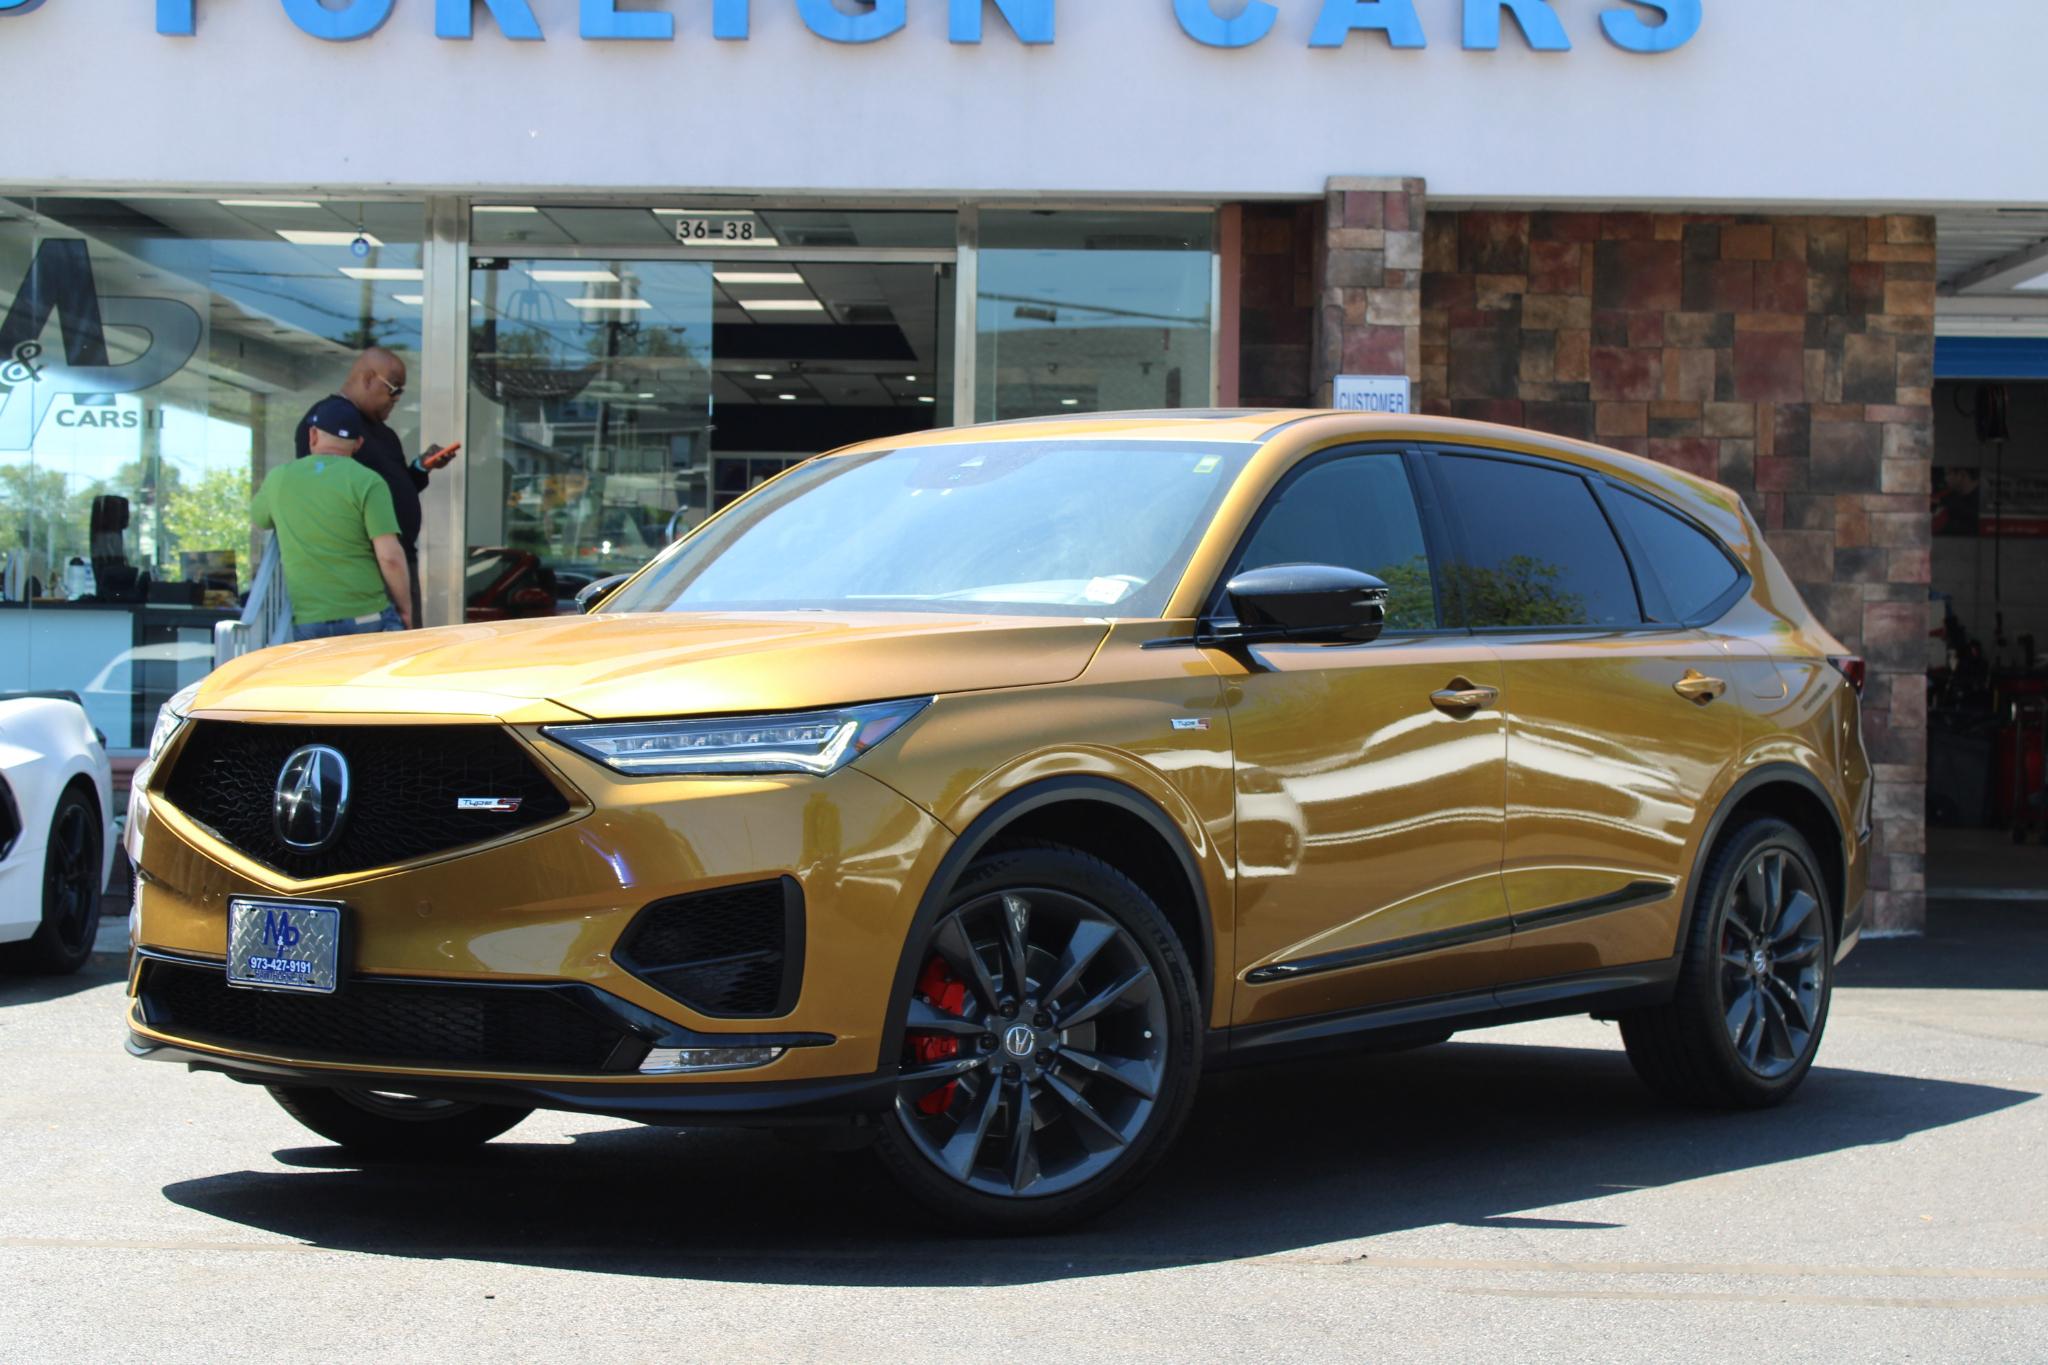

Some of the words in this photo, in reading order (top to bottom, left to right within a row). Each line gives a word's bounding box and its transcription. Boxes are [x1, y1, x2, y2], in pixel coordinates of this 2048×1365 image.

[679, 220, 753, 240] 36-38
[1339, 392, 1405, 413] CUSTOMER
[56, 409, 138, 428] CARS
[461, 798, 495, 808] Type
[250, 957, 312, 974] 973-427-9191
